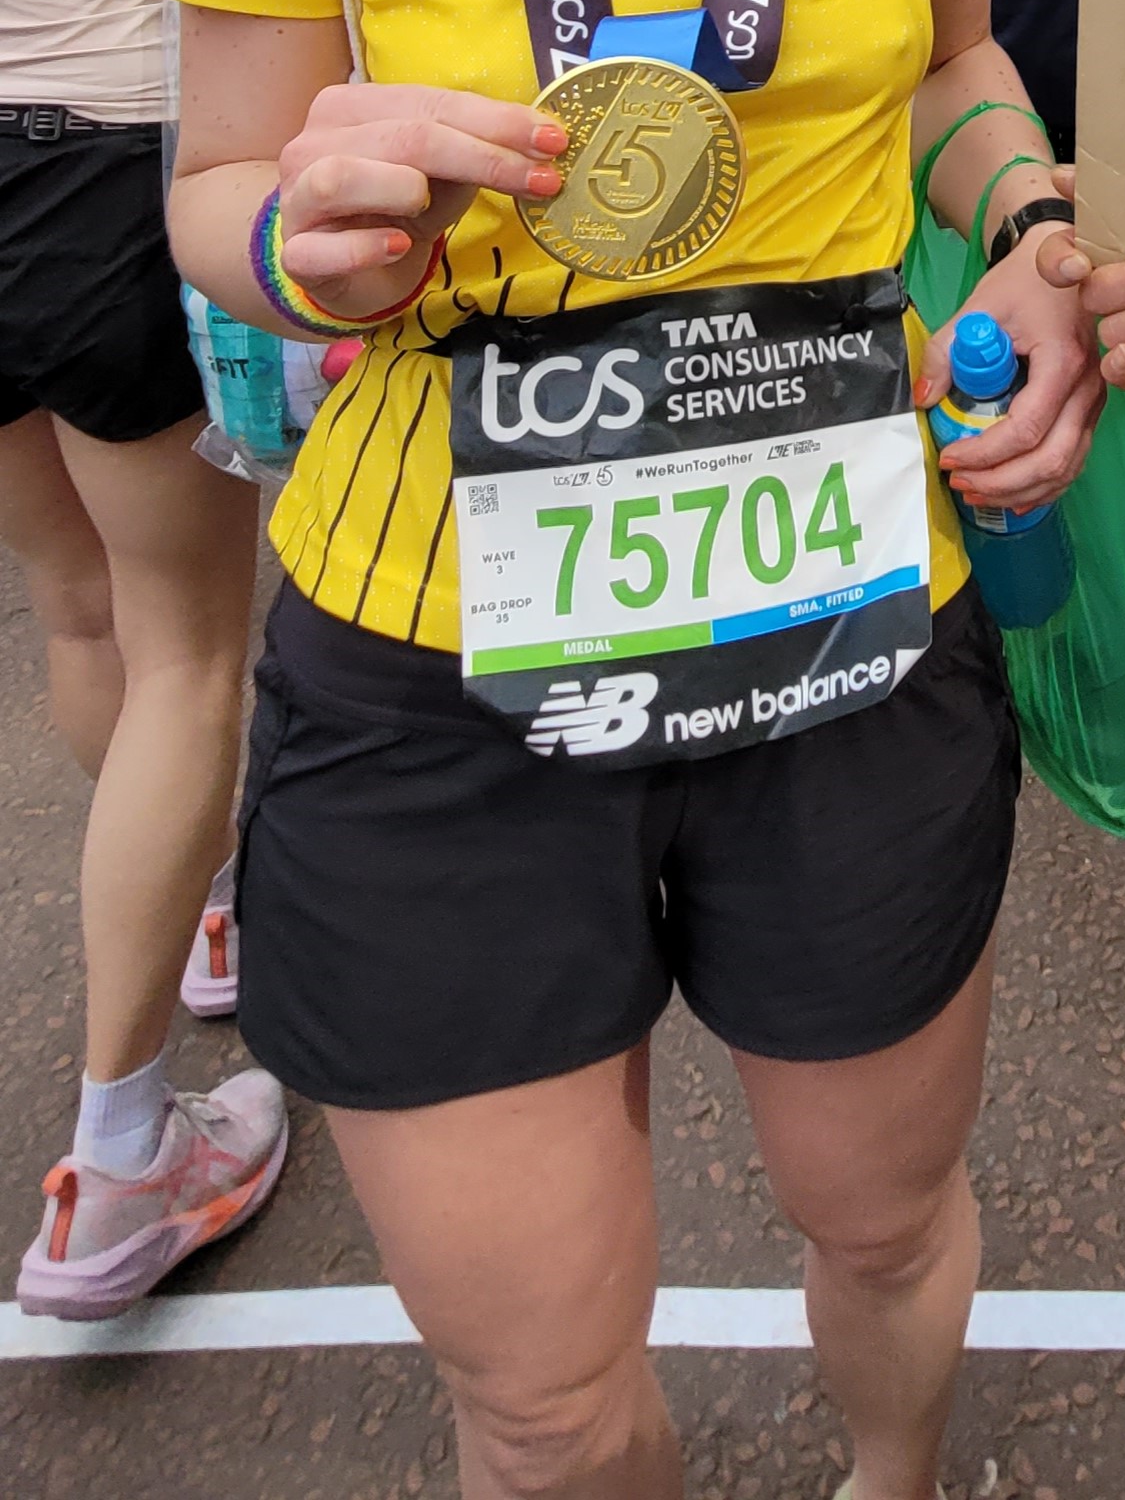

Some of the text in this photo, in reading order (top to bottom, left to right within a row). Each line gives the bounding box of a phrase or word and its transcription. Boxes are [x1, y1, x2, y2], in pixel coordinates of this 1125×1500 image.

[661, 312, 758, 348] TATA
[664, 330, 874, 385] CONSULTANCY
[481, 343, 645, 443] tcs
[666, 376, 807, 423] SERVICES
[635, 452, 754, 479] #WeRunTogether
[536, 461, 863, 616] 75704
[482, 551, 516, 563] WAVE
[497, 565, 503, 575] 3
[471, 597, 532, 615] BAG DROP
[826, 586, 864, 608] FITTED
[496, 613, 509, 624] 35
[563, 638, 613, 657] MEDAL
[524, 672, 659, 757] NB
[665, 656, 891, 743] new balance
